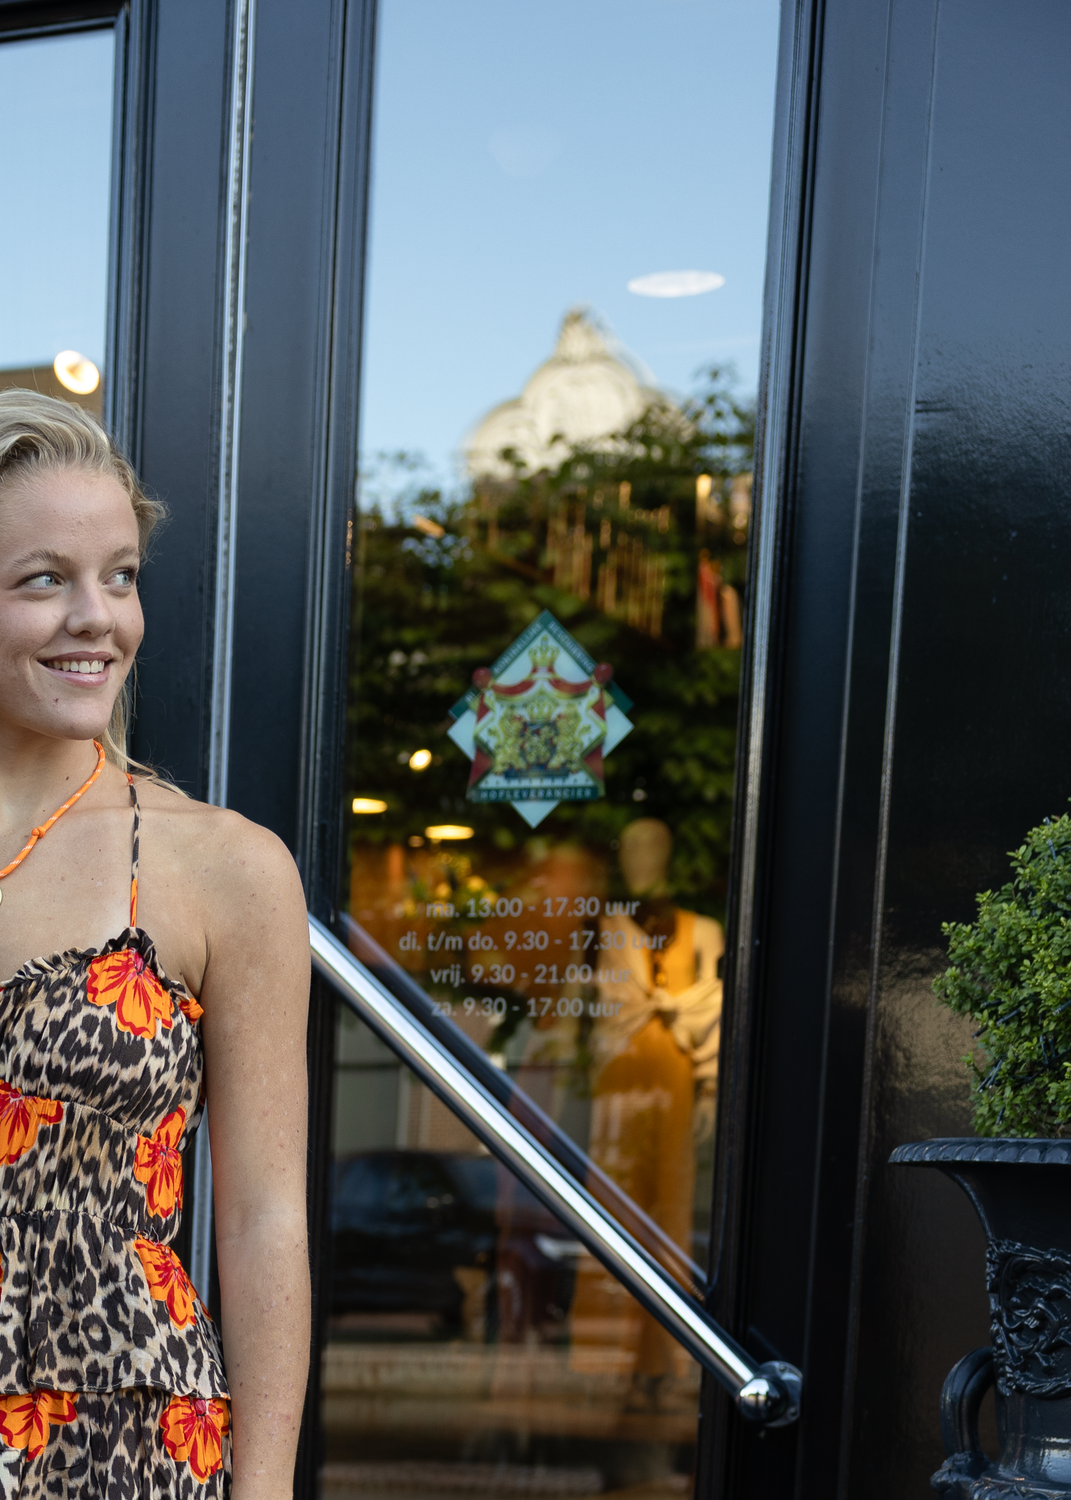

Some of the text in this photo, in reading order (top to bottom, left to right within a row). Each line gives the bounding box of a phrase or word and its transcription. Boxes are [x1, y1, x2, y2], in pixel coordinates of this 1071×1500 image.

[480, 788, 592, 800] HOFLEVERANCIER
[426, 903, 460, 918] ma.
[466, 897, 523, 918] 13.00
[542, 896, 600, 917] 17.30
[605, 901, 640, 917] uur
[399, 930, 422, 951] di.
[427, 930, 463, 952] t/m
[468, 930, 498, 951] do.
[504, 930, 549, 951] 9.30
[569, 930, 626, 950] 17.30
[632, 935, 667, 950] uur
[430, 963, 465, 988] vrij.
[471, 963, 516, 984] 9.30
[534, 963, 593, 984] 21.00
[597, 969, 632, 983] uur
[431, 1001, 457, 1017] za.
[463, 997, 507, 1017] 9.30
[527, 997, 584, 1018] 17.00
[588, 1002, 623, 1017] uur
